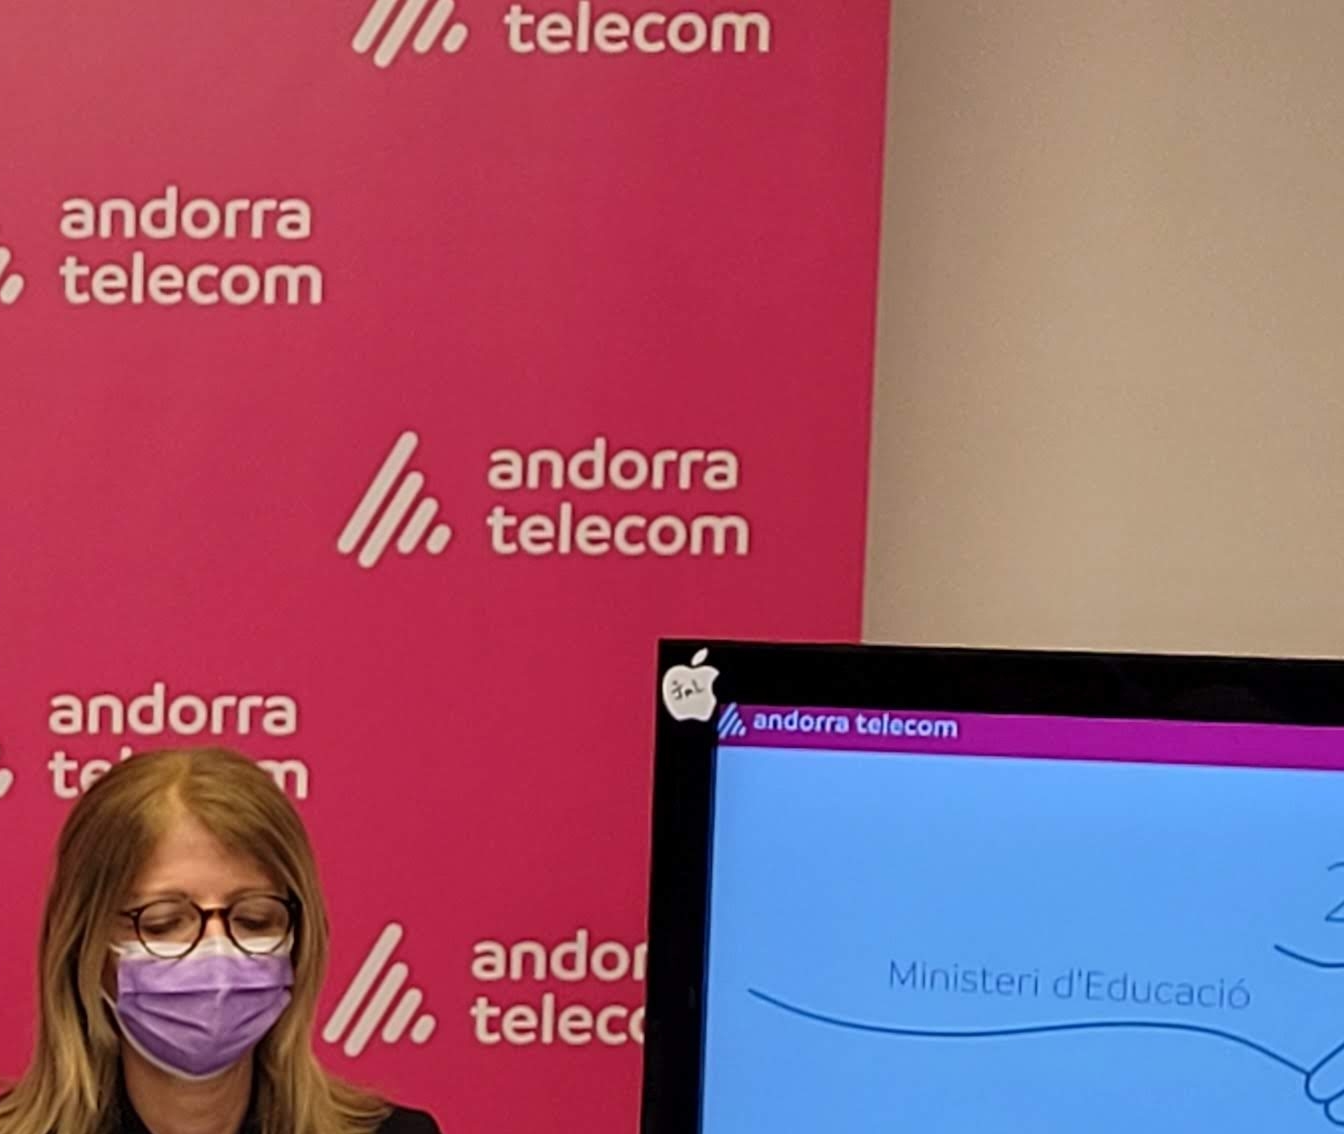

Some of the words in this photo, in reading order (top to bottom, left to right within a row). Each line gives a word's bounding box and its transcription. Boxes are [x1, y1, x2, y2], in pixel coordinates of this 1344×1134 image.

[504, 0, 770, 53] telecom
[60, 186, 312, 238] andorra
[60, 252, 322, 305] telecom
[487, 438, 738, 490] andorra
[486, 503, 748, 556] telecom
[49, 682, 297, 735] andorra
[753, 710, 849, 734] andorra
[856, 712, 958, 738] telecom
[471, 929, 647, 981] andor
[889, 960, 1041, 997] Ministeri
[1053, 968, 1251, 1010] d'Educació
[470, 993, 644, 1044] telec
